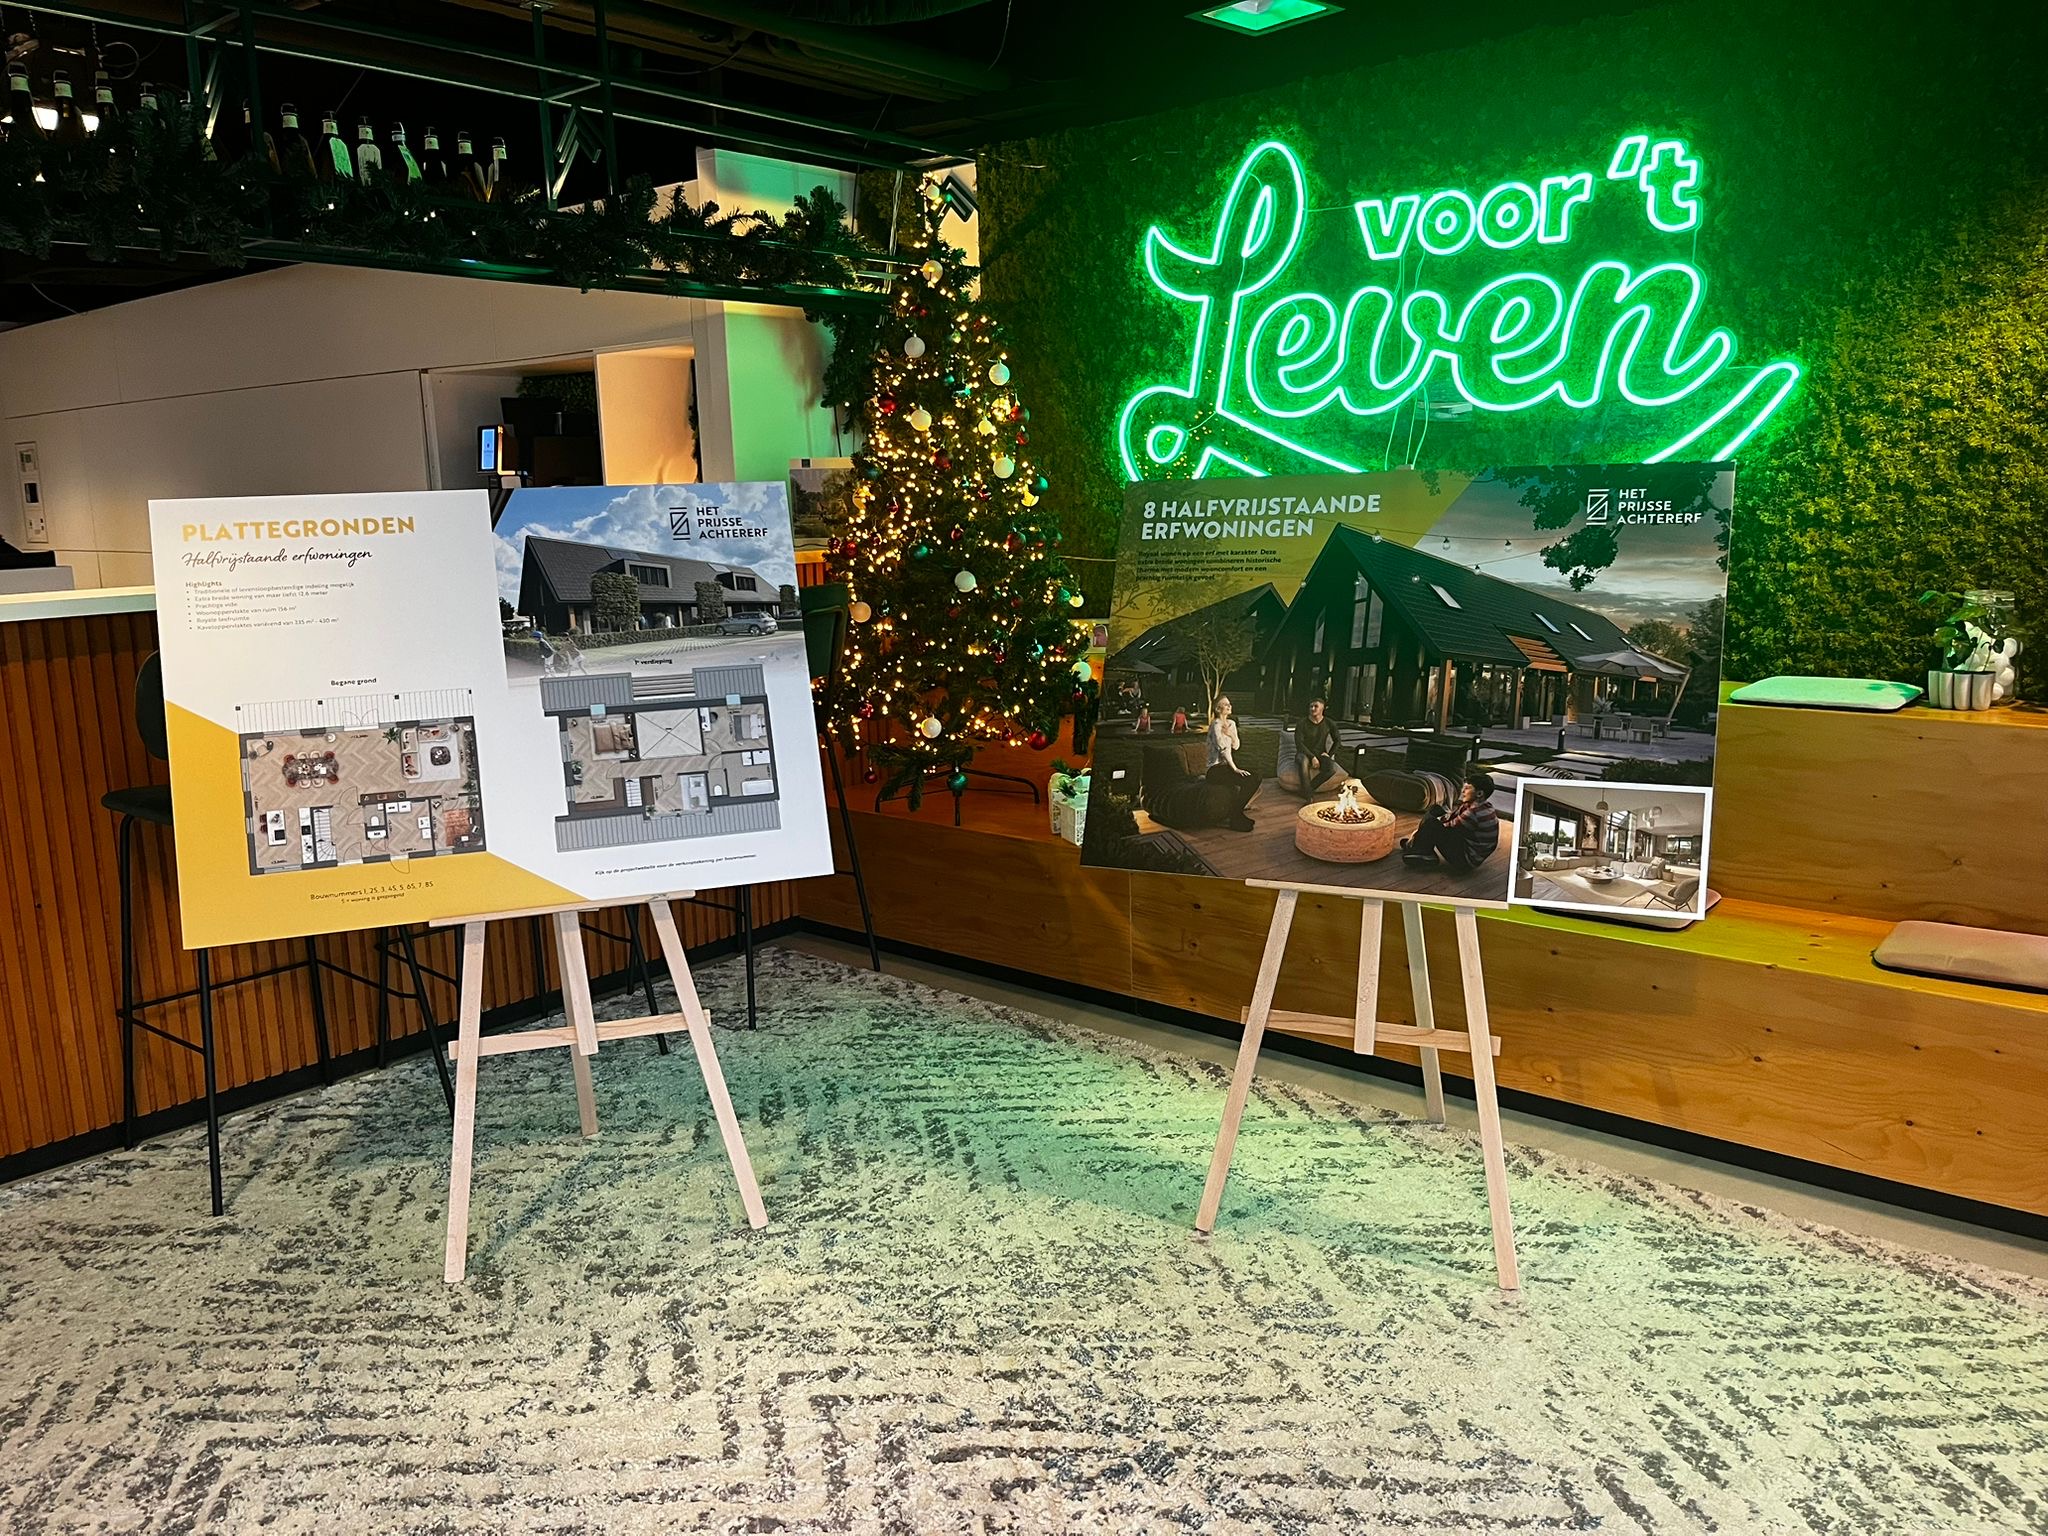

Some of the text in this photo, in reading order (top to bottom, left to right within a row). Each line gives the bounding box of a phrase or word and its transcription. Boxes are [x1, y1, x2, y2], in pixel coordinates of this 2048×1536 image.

[1354, 171, 1593, 261] voor
[1118, 140, 1801, 482] Leven
[1619, 488, 1647, 499] HET
[696, 506, 720, 517] HET
[1143, 494, 1382, 519] 8 HALFVRIJSTAANDE
[1617, 500, 1672, 512] PRIJSSE
[697, 516, 743, 528] PRIJSSE
[1616, 513, 1702, 526] ACHTERERF
[181, 515, 416, 543] PLATTEGRONDEN
[699, 527, 769, 540] ACHTERERF
[1140, 518, 1314, 541] ERFWONINGEN
[180, 546, 374, 573] Halfvrijstaande erfwoningen
[356, 677, 377, 686] grond
